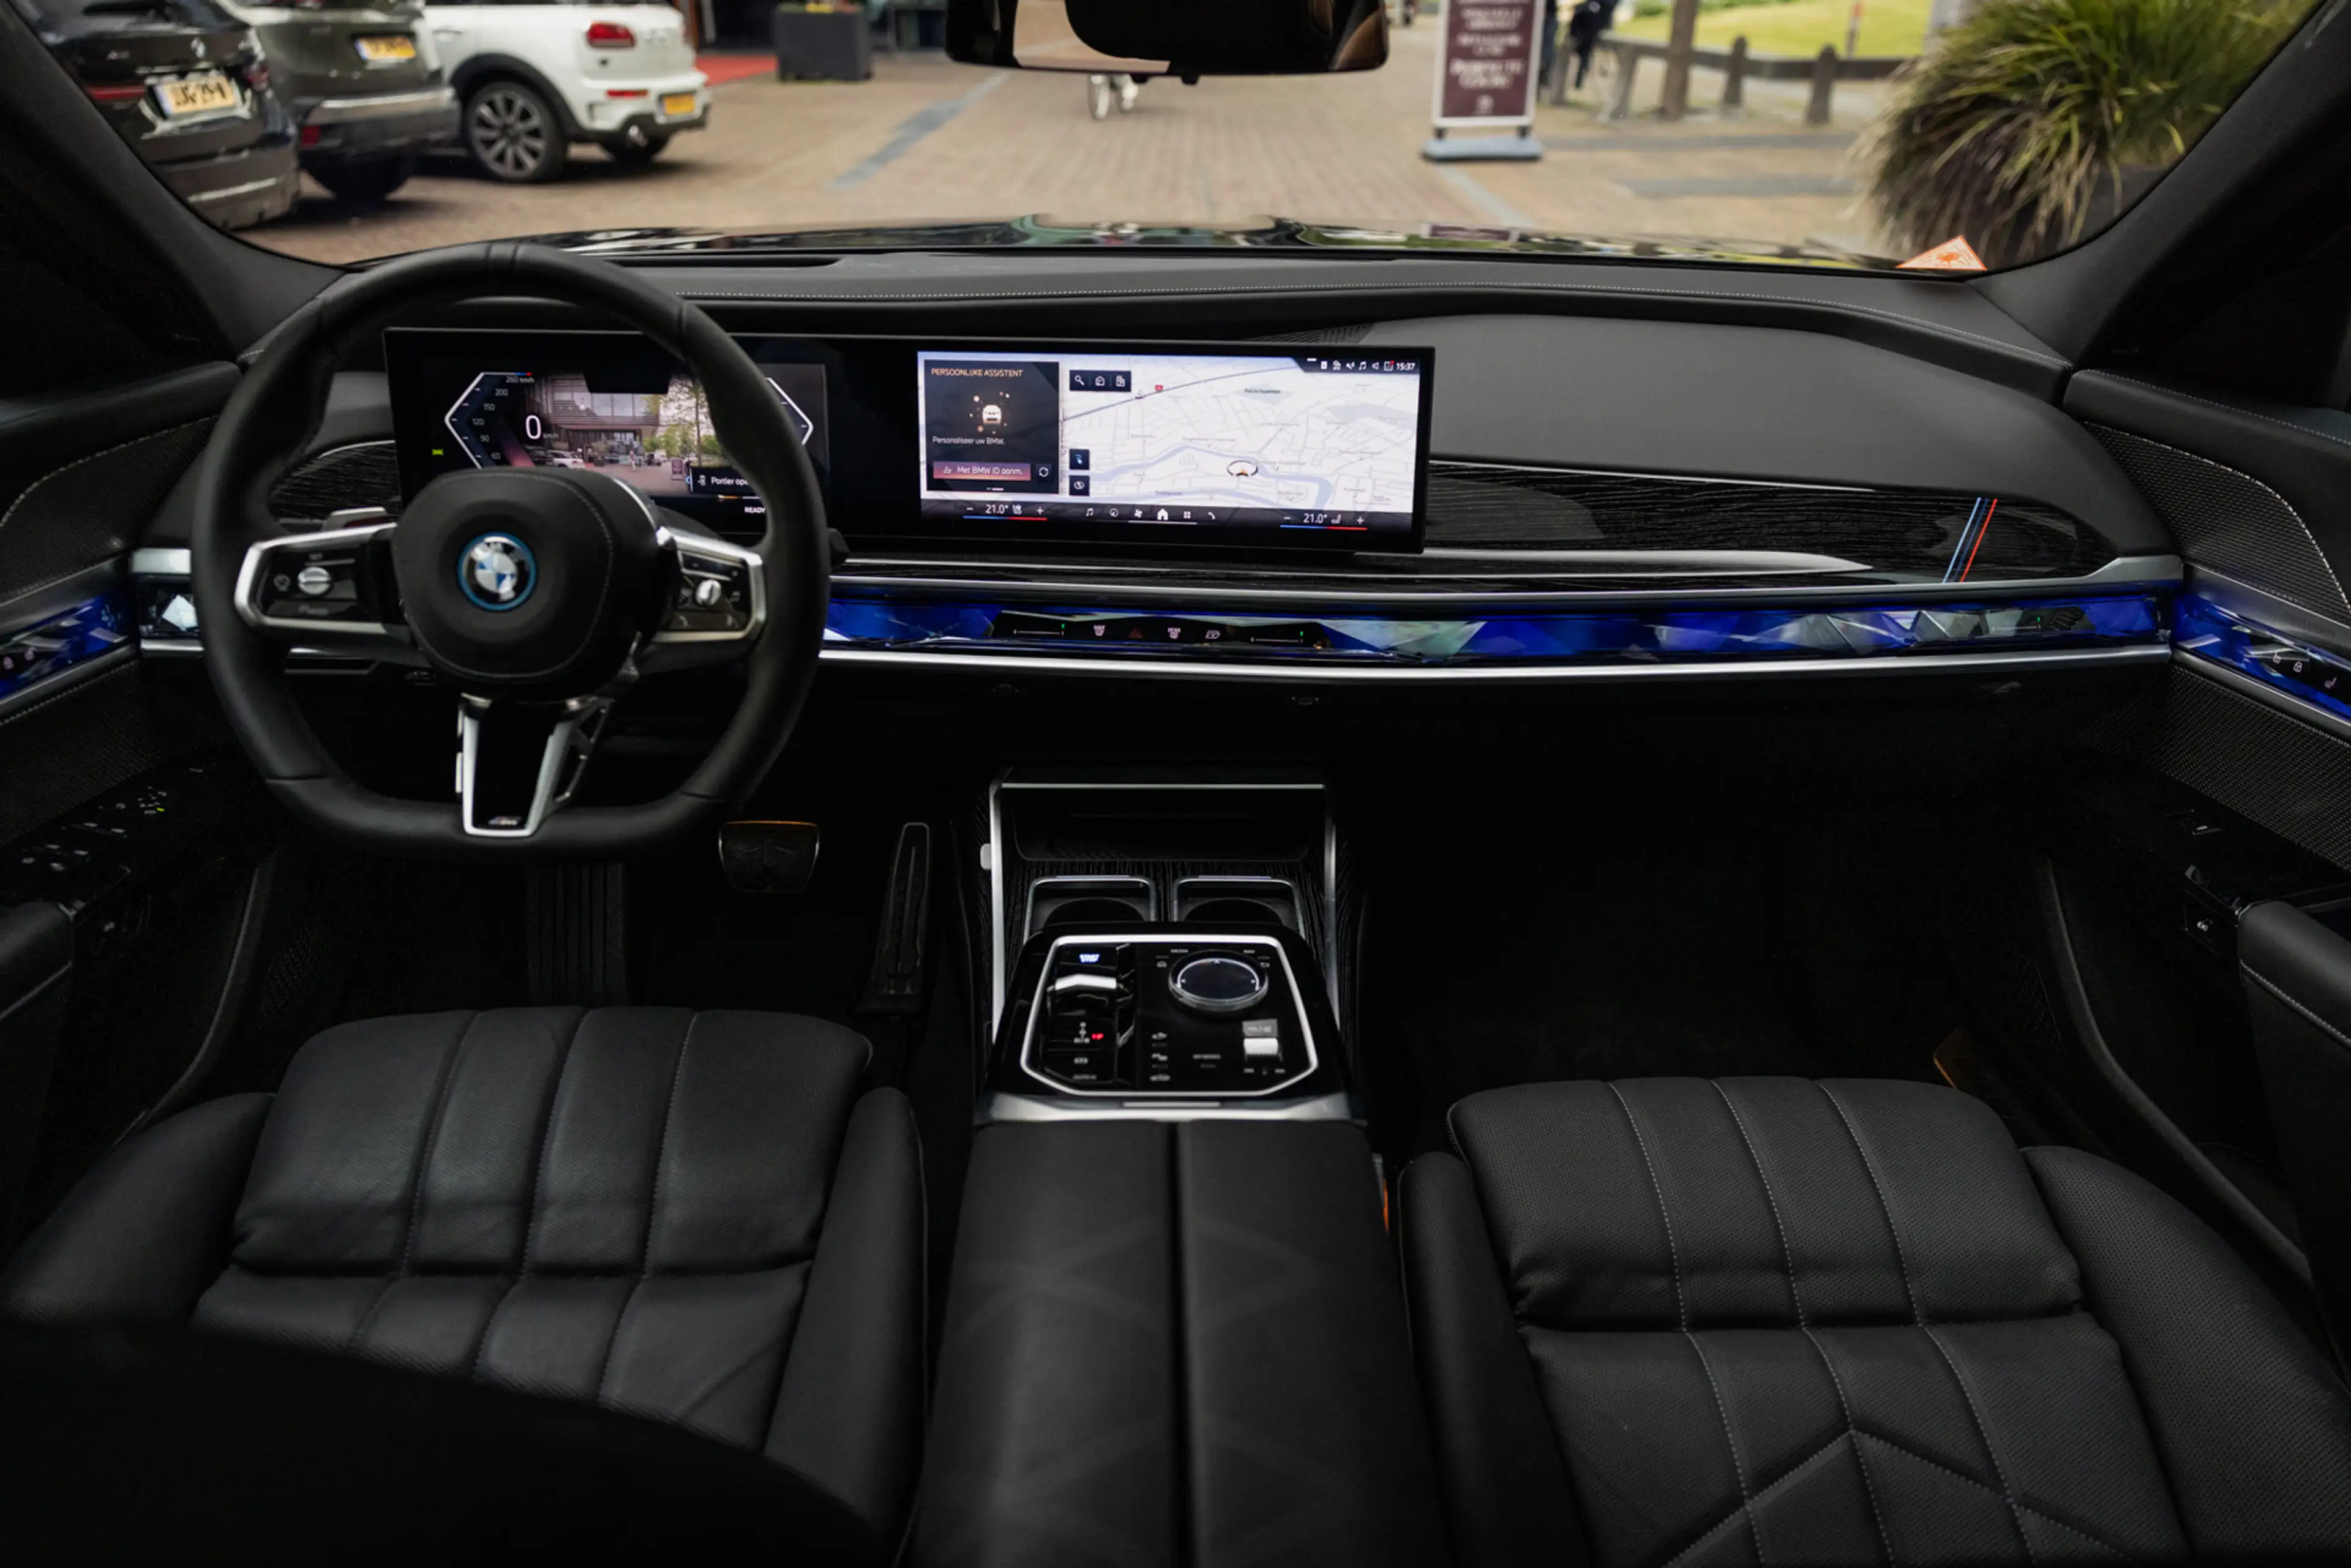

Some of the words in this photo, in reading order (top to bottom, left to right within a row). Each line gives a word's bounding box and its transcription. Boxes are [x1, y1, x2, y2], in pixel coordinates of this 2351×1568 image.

[931, 368, 983, 377] PERSOONLIJKE
[525, 415, 541, 440] 0
[932, 437, 975, 445] Personaliseer
[711, 476, 735, 486] Portier
